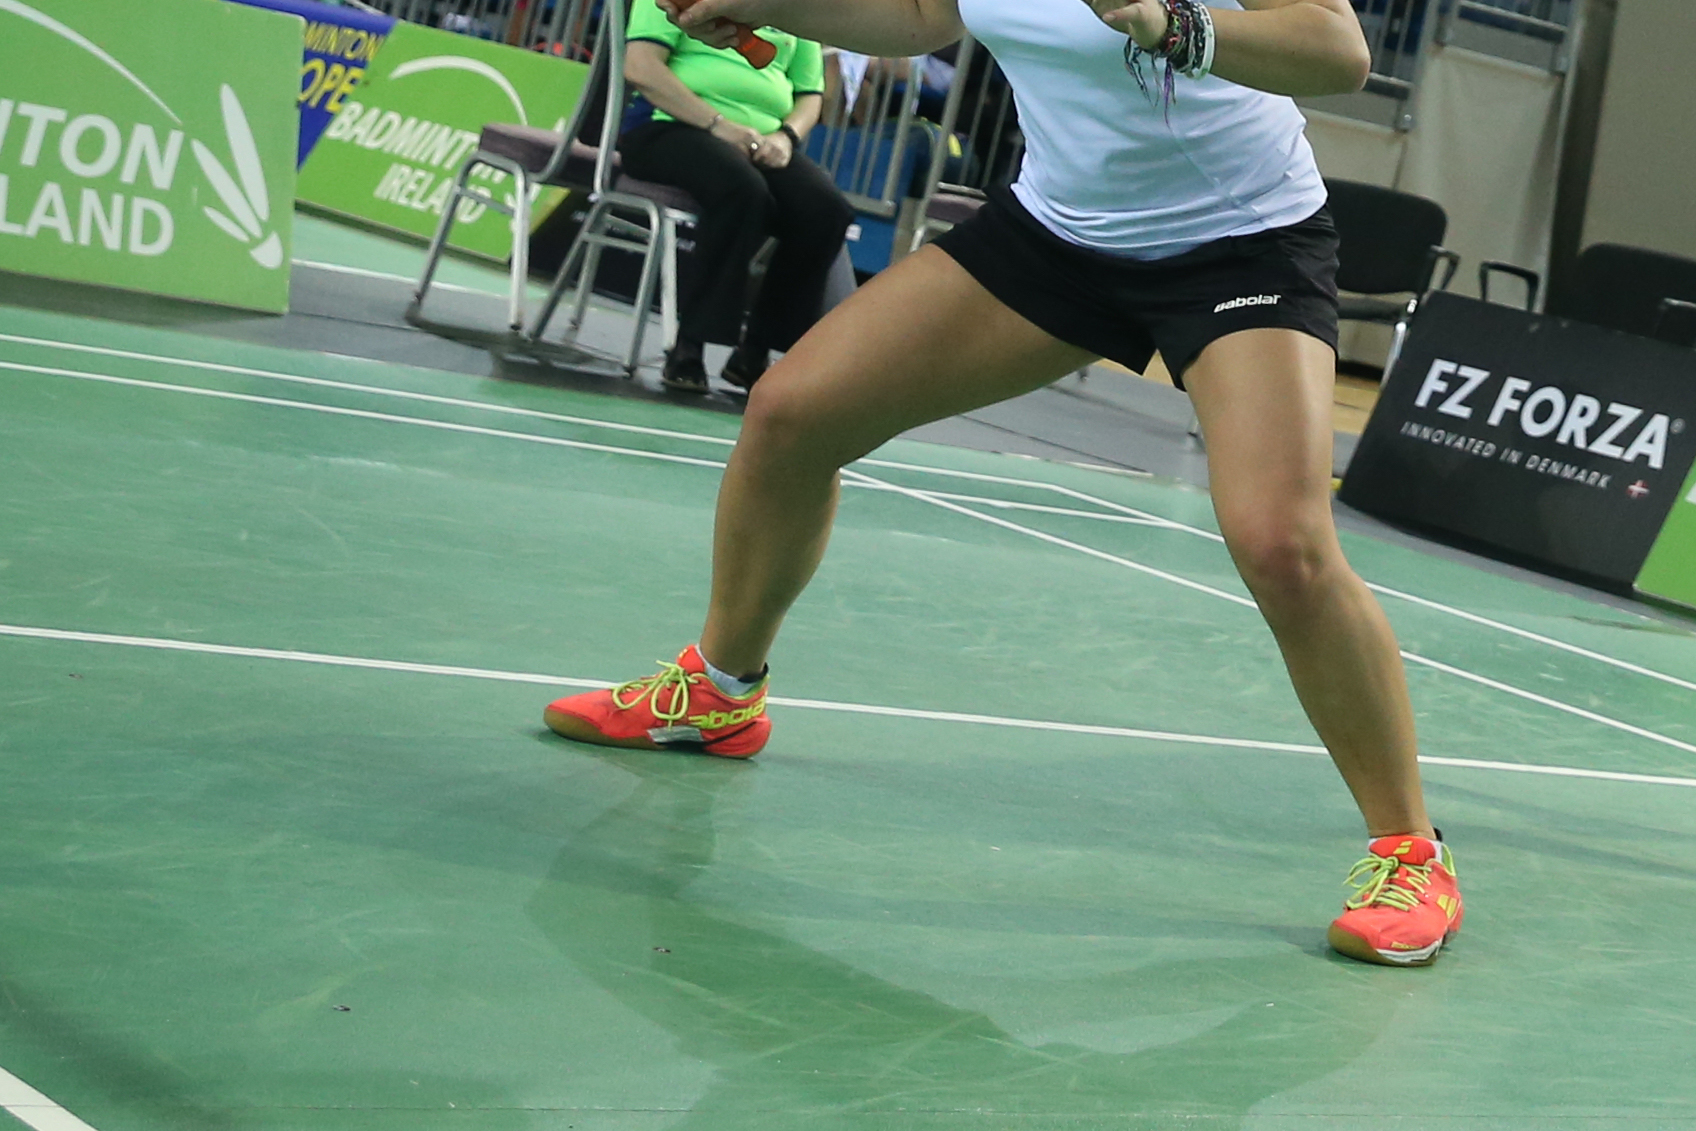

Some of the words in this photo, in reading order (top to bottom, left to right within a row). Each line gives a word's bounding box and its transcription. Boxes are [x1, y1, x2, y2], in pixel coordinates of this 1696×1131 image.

[305, 20, 385, 62] MINTON
[297, 58, 366, 114] OPE
[326, 101, 507, 184] BADMINT
[373, 162, 492, 224] IRELAD
[1414, 358, 1491, 419] FZ
[1486, 375, 1671, 470] FORZA
[1400, 420, 1497, 459] INNOVATED
[1499, 446, 1523, 465] IN
[1525, 454, 1613, 489] DENMARK
